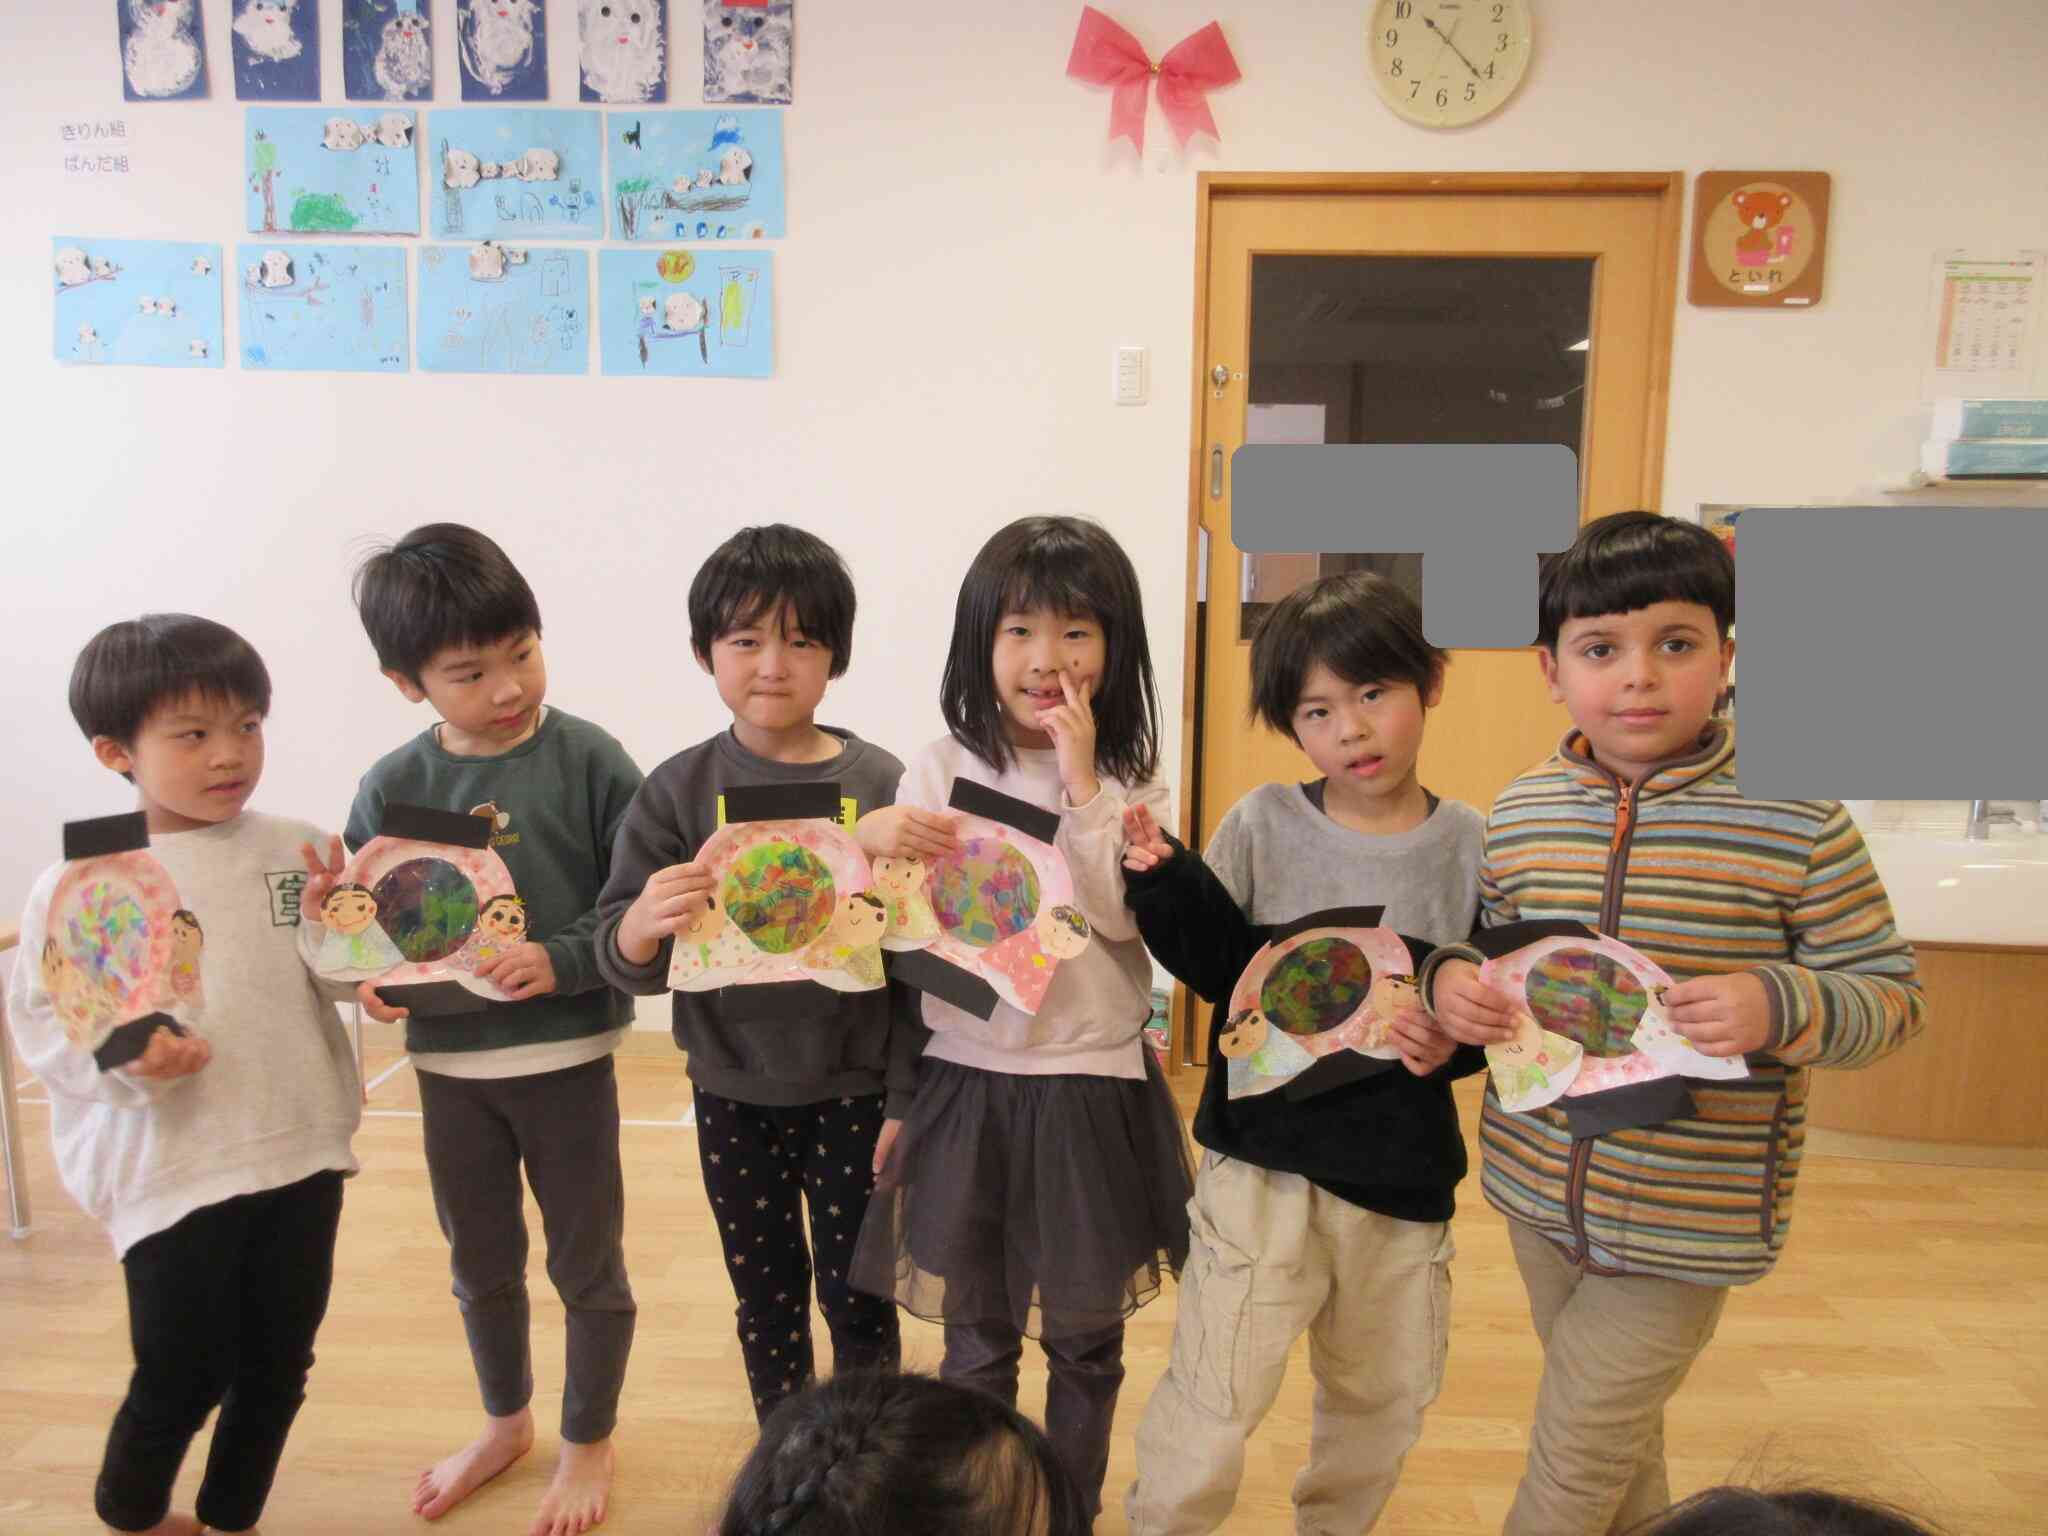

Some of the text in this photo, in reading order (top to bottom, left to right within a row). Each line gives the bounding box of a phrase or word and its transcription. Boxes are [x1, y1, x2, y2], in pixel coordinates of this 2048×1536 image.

[1395, 0, 1412, 19] 10
[1491, 3, 1504, 23] 2
[1386, 28, 1398, 48] 9
[1495, 33, 1508, 53] 3
[1391, 57, 1402, 77] 8
[1482, 60, 1495, 79] 4
[1410, 80, 1421, 99] 7
[1435, 88, 1447, 107] 6
[1464, 82, 1475, 102] 5
[1729, 267, 1783, 283] といれ
